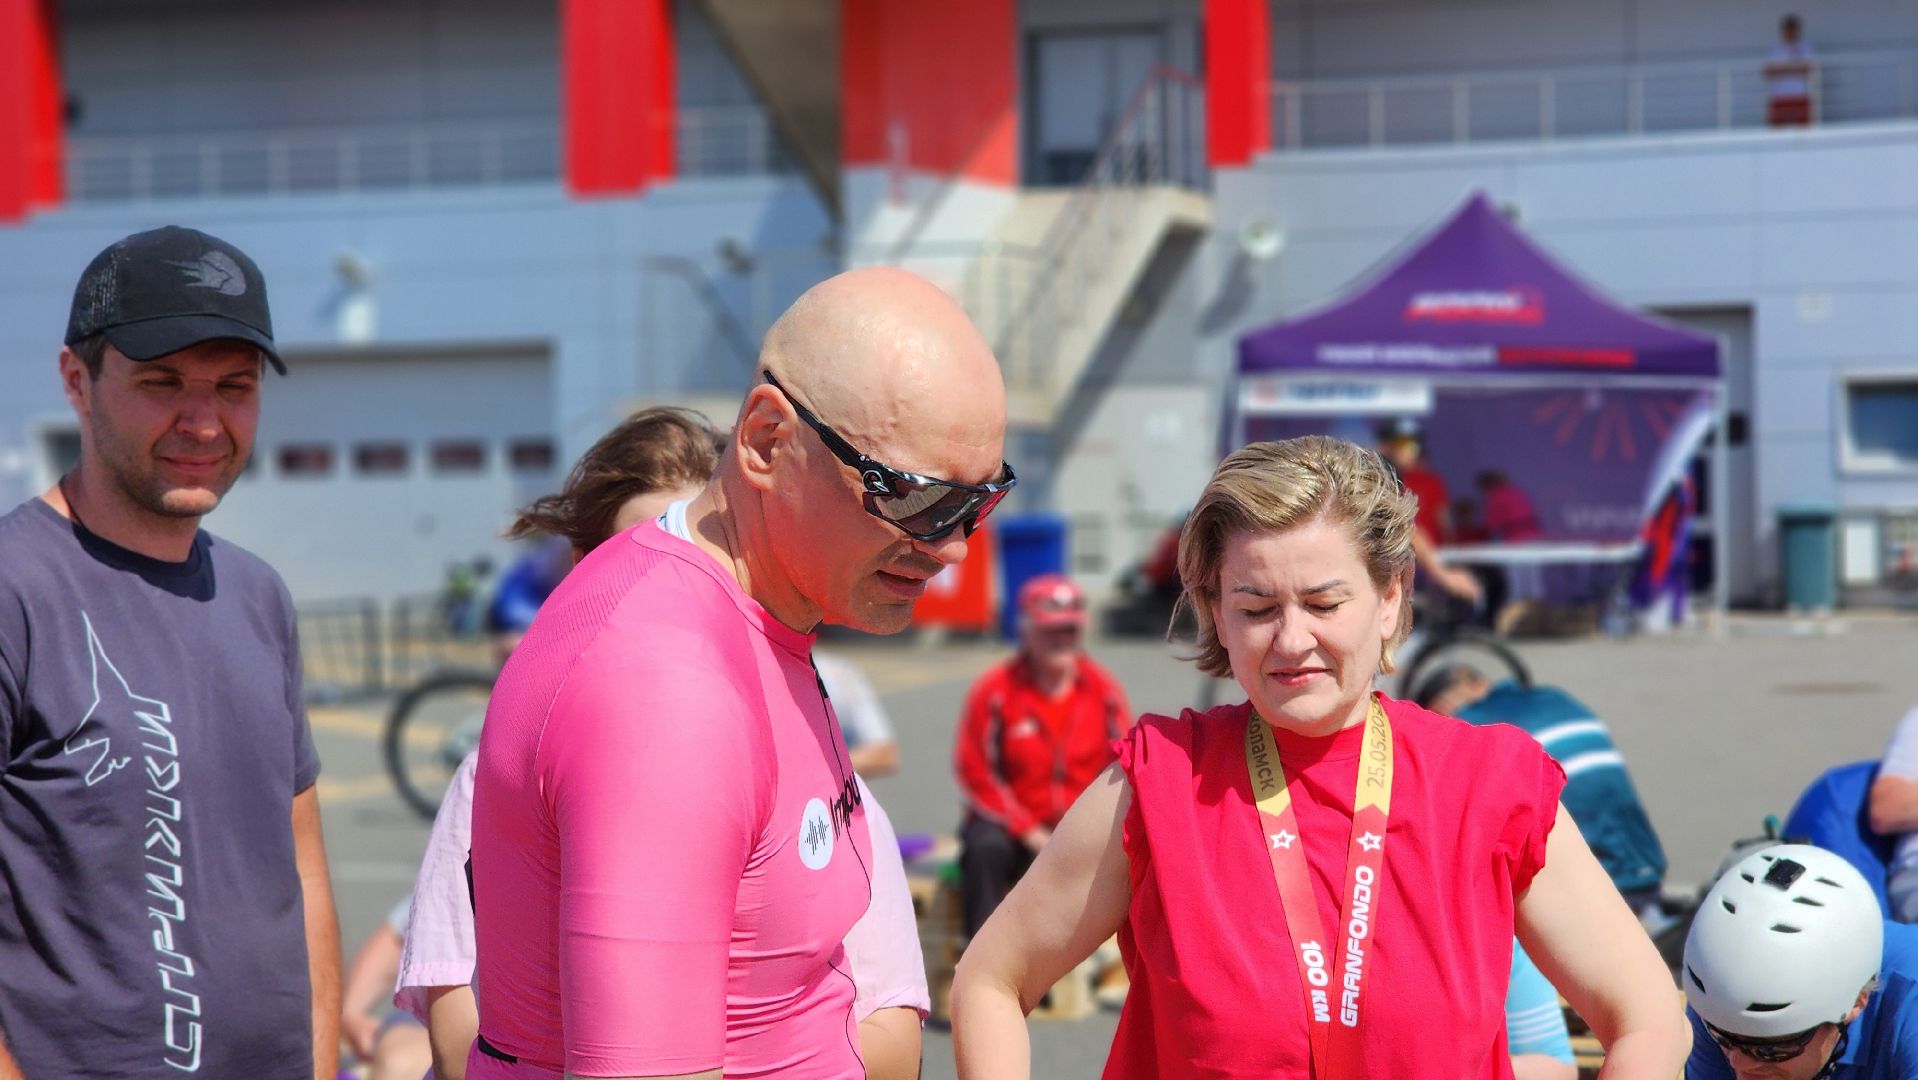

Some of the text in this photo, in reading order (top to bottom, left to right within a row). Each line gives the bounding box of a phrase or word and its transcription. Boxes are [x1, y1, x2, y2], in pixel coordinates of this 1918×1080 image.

[1366, 699, 1387, 789] 25.05.202
[829, 771, 862, 843] Impu
[1300, 940, 1329, 987] 100
[1340, 865, 1375, 1028] GRANFONDO
